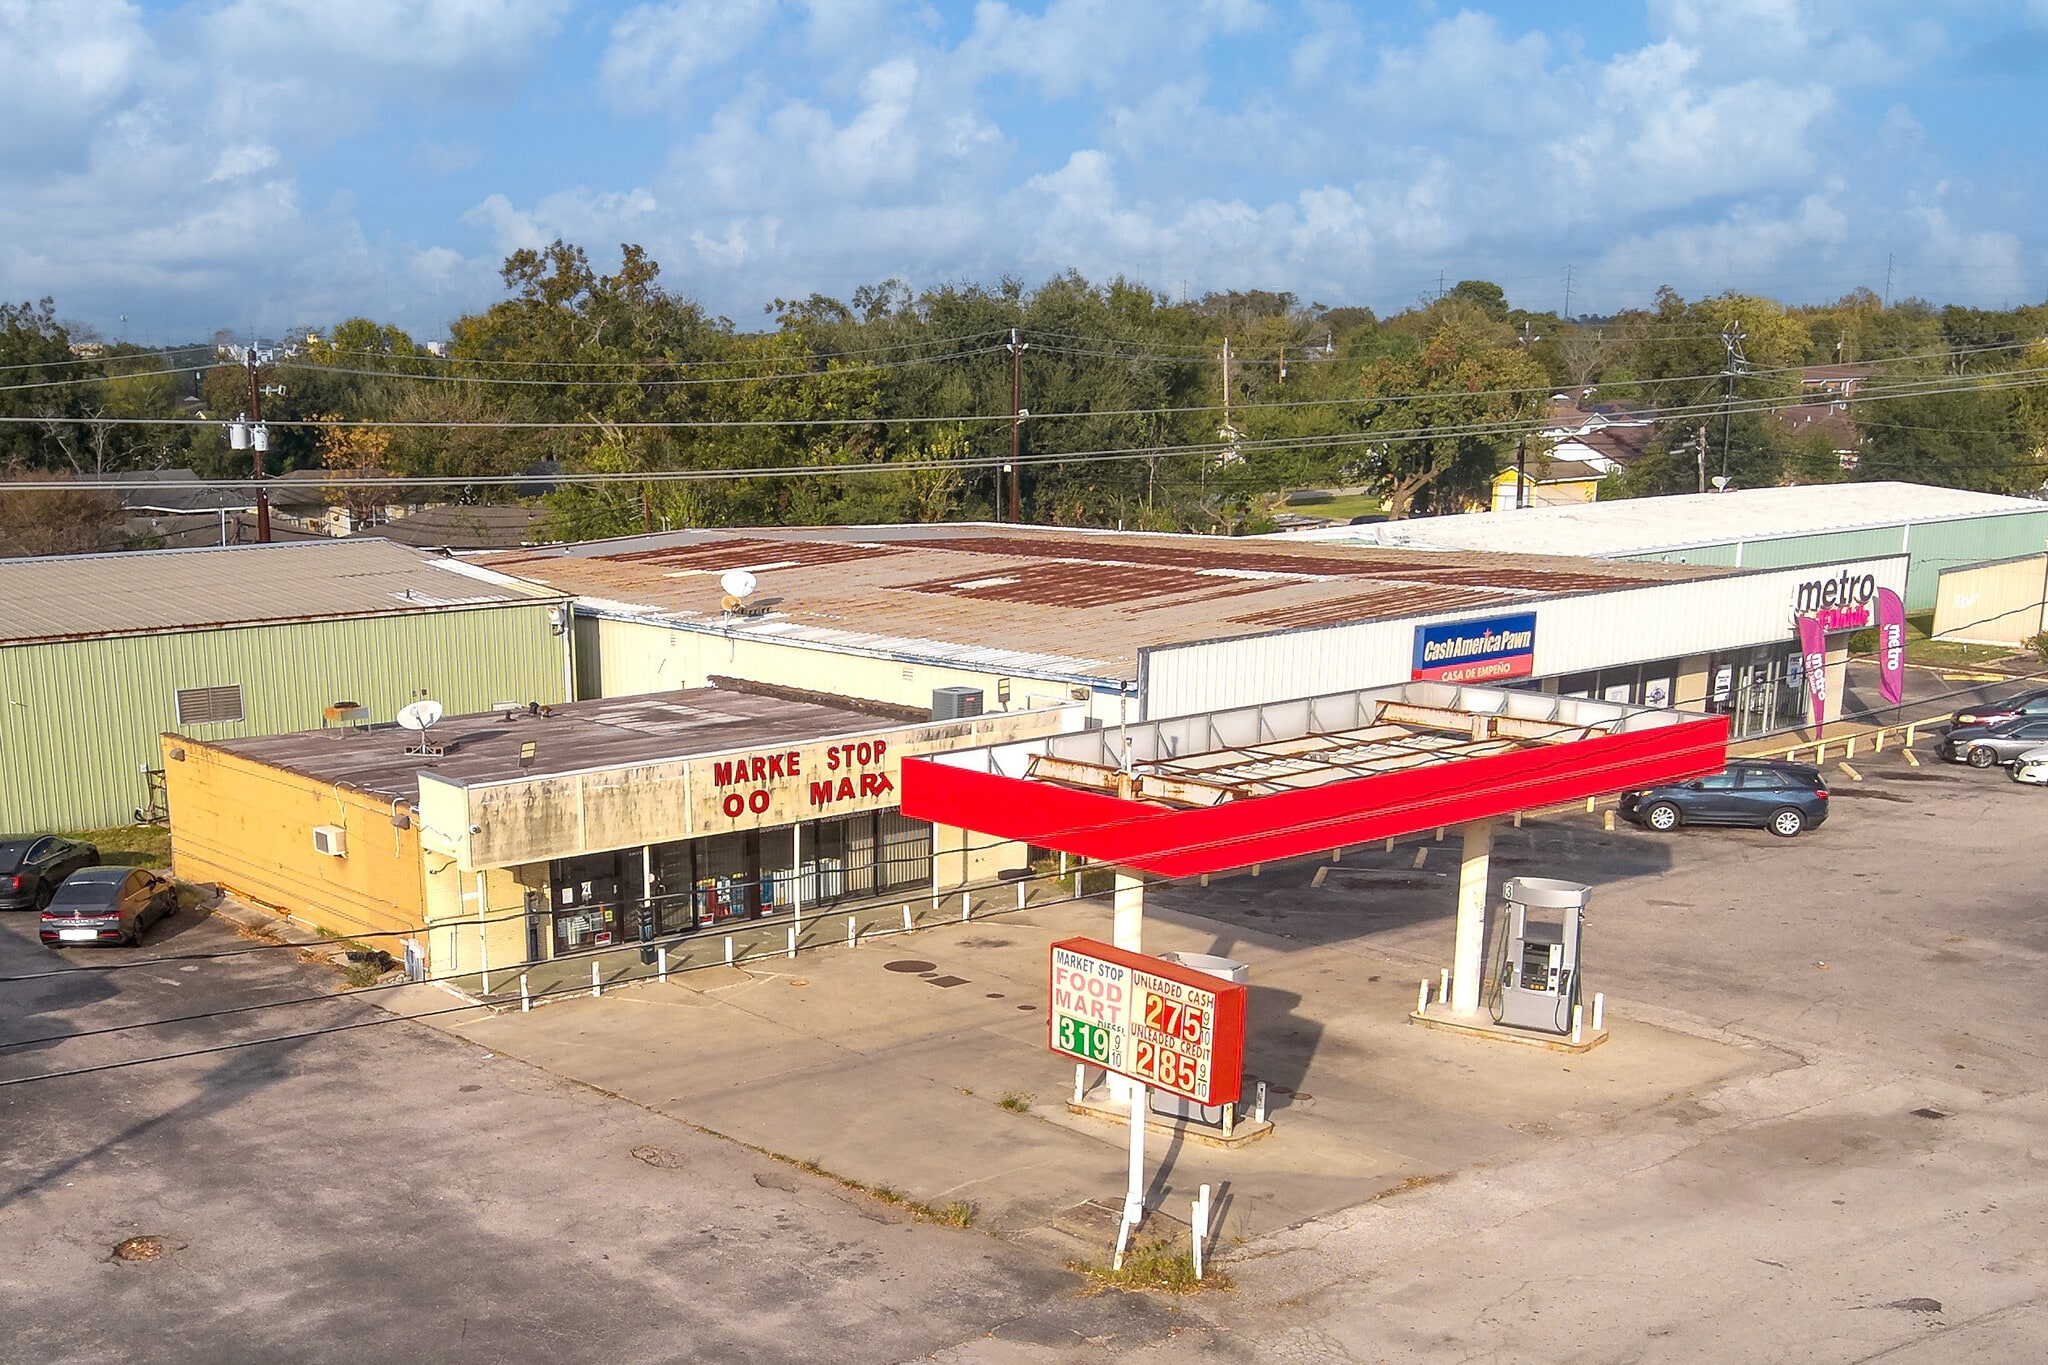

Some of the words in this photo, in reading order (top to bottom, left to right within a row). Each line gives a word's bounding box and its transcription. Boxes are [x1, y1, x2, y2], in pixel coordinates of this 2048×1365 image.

[1797, 569, 1875, 611] metro
[1424, 638, 1453, 662] Cash
[1453, 628, 1501, 658] America
[1501, 630, 1531, 650] Pawn
[1887, 624, 1903, 671] metro
[1441, 669, 1464, 682] CASA
[1465, 667, 1476, 678] DE
[1811, 653, 1826, 701] metro
[714, 751, 800, 787] MARKE
[827, 739, 887, 771] STOP
[1505, 885, 1512, 899] 3
[1057, 950, 1095, 974] MARKET
[1098, 962, 1124, 982] STOP
[1056, 967, 1123, 1004] FOOD
[1134, 973, 1182, 998] UNLEADED
[1188, 990, 1214, 1009] CASH
[1055, 988, 1122, 1024] MART
[1145, 994, 1201, 1043] 275
[1060, 1017, 1108, 1061] 319
[1131, 1023, 1175, 1049] UNLEADED
[1180, 1041, 1211, 1061] CREDIT
[1136, 1043, 1195, 1091] 285
